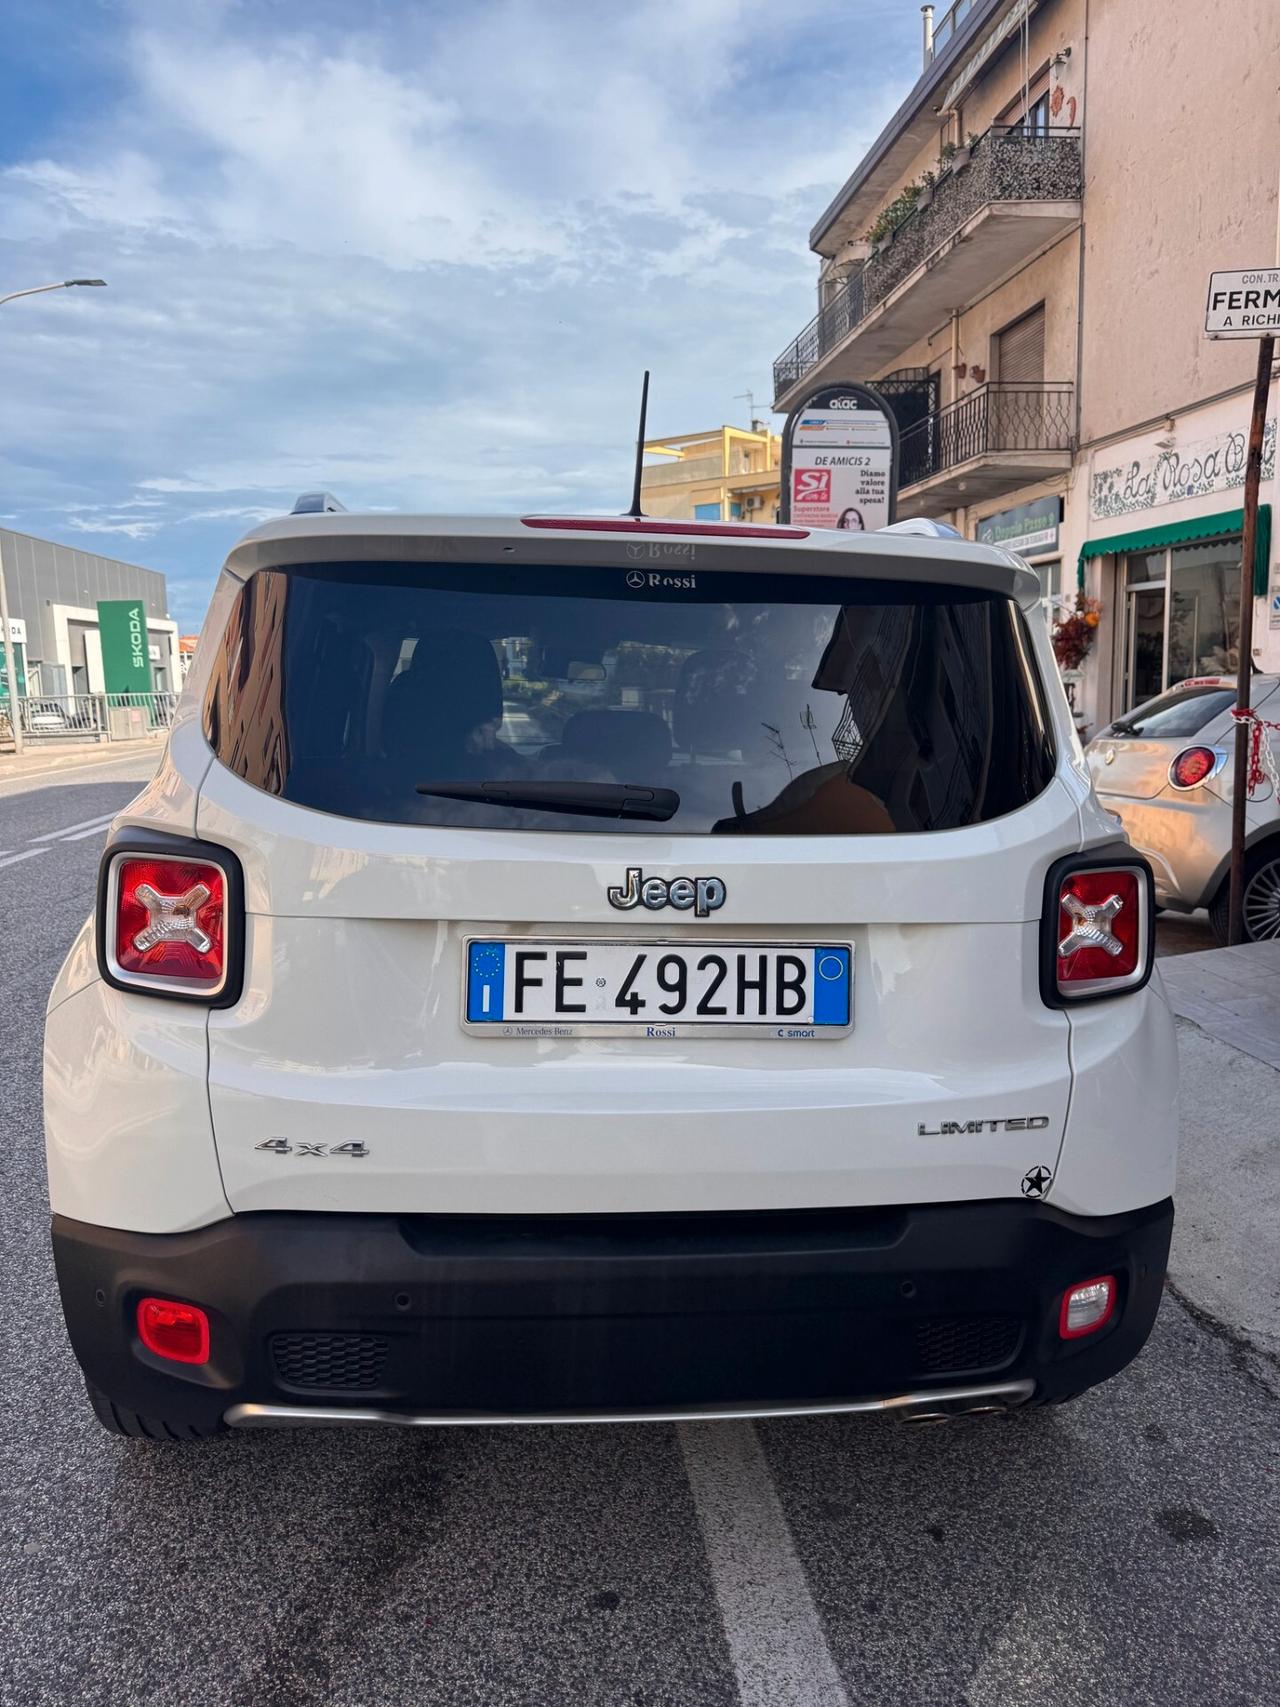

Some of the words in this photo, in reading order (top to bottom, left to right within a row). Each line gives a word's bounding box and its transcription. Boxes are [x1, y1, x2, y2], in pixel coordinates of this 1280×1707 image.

[1212, 289, 1280, 311] FERM
[1223, 316, 1232, 326] A
[815, 456, 830, 466] DE
[830, 456, 863, 466] AMICIS
[864, 457, 871, 466] 2
[1123, 460, 1151, 501] La
[1162, 448, 1222, 490] Rosa
[859, 497, 885, 505] spesa!
[648, 572, 696, 588] Rossi
[607, 867, 727, 917] Jeep
[514, 951, 588, 1013] FE
[614, 954, 807, 1016] 492HB
[646, 1026, 676, 1038] Rossi
[787, 1028, 815, 1038] smart
[917, 1116, 1049, 1136] LIMITED
[254, 1136, 370, 1158] 4x4
